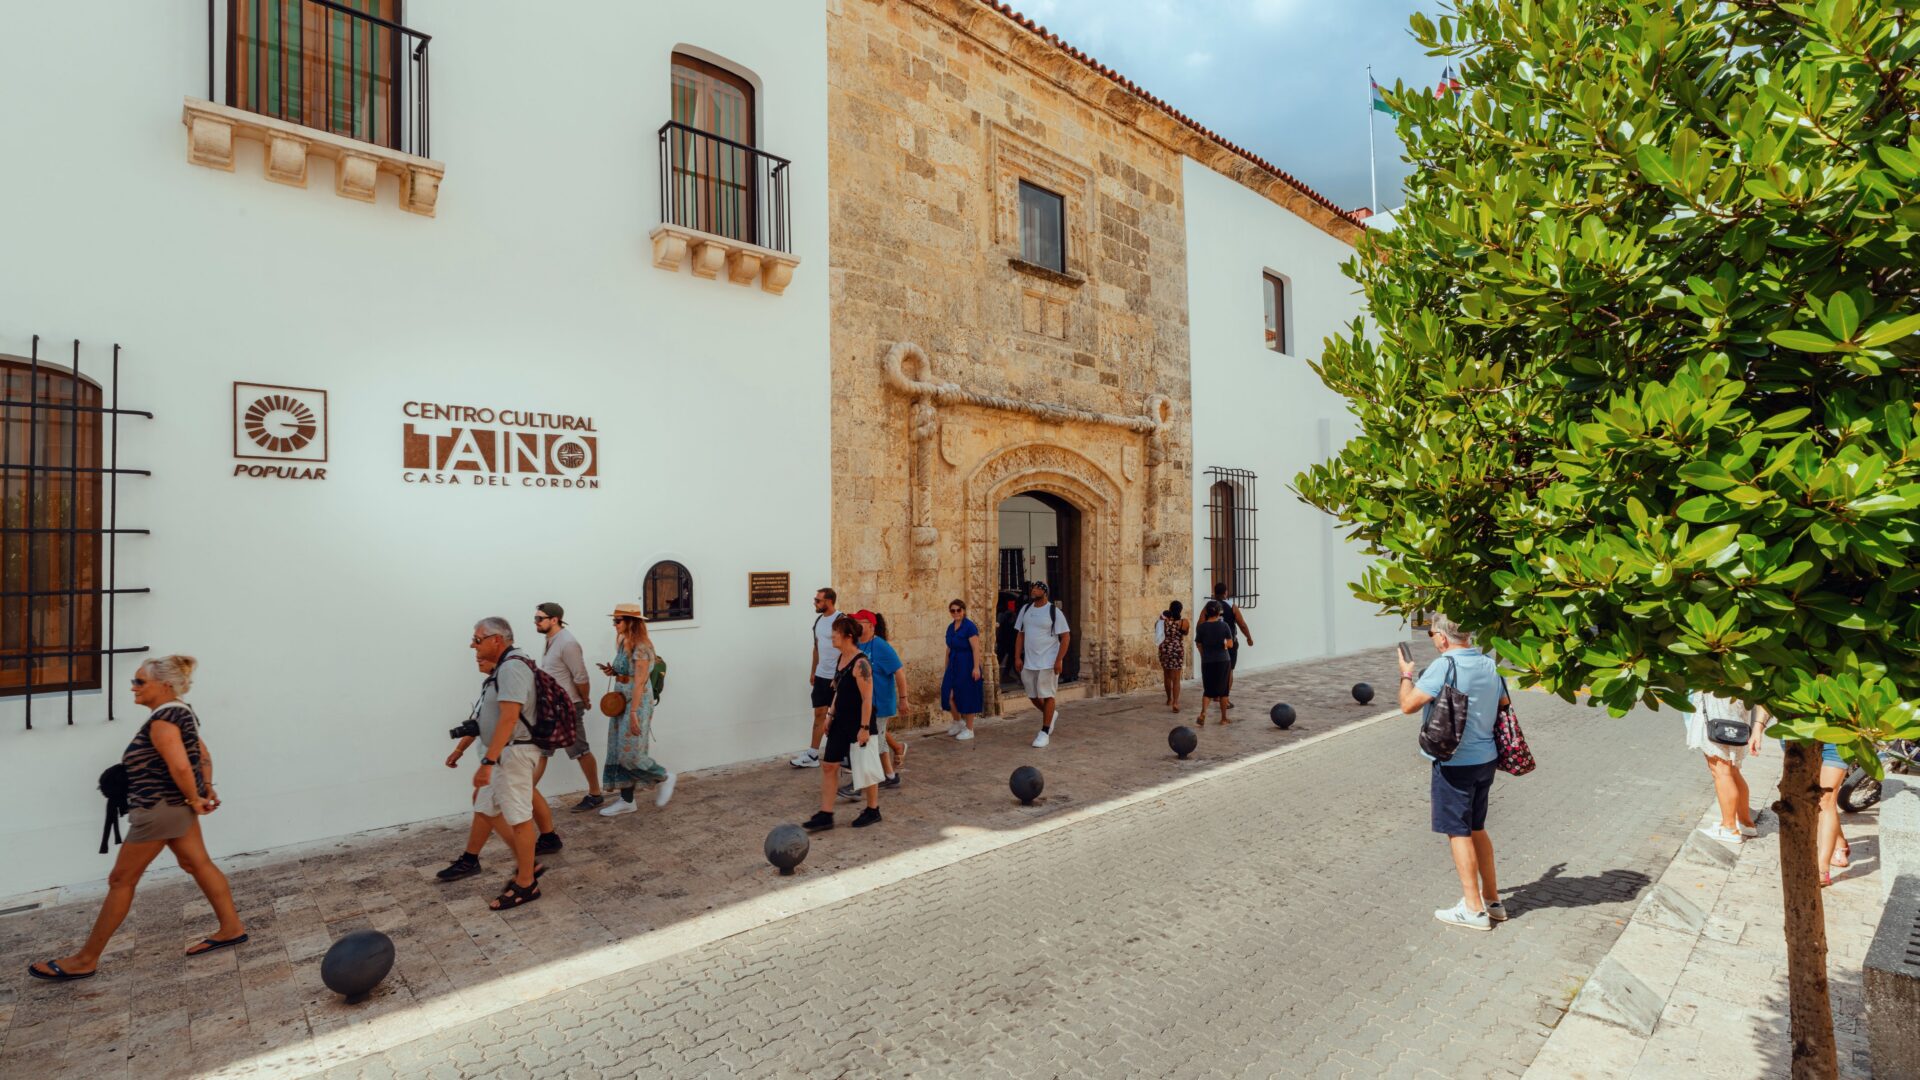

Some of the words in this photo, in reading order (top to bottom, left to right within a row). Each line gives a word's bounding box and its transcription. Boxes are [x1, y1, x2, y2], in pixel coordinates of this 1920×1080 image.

[403, 401, 494, 423] CENTRO
[499, 410, 597, 431] CULTURAL
[233, 464, 327, 480] POPULAR
[403, 472, 460, 484] CASA
[474, 475, 511, 487] DEL
[522, 476, 599, 489] CORDÓN
